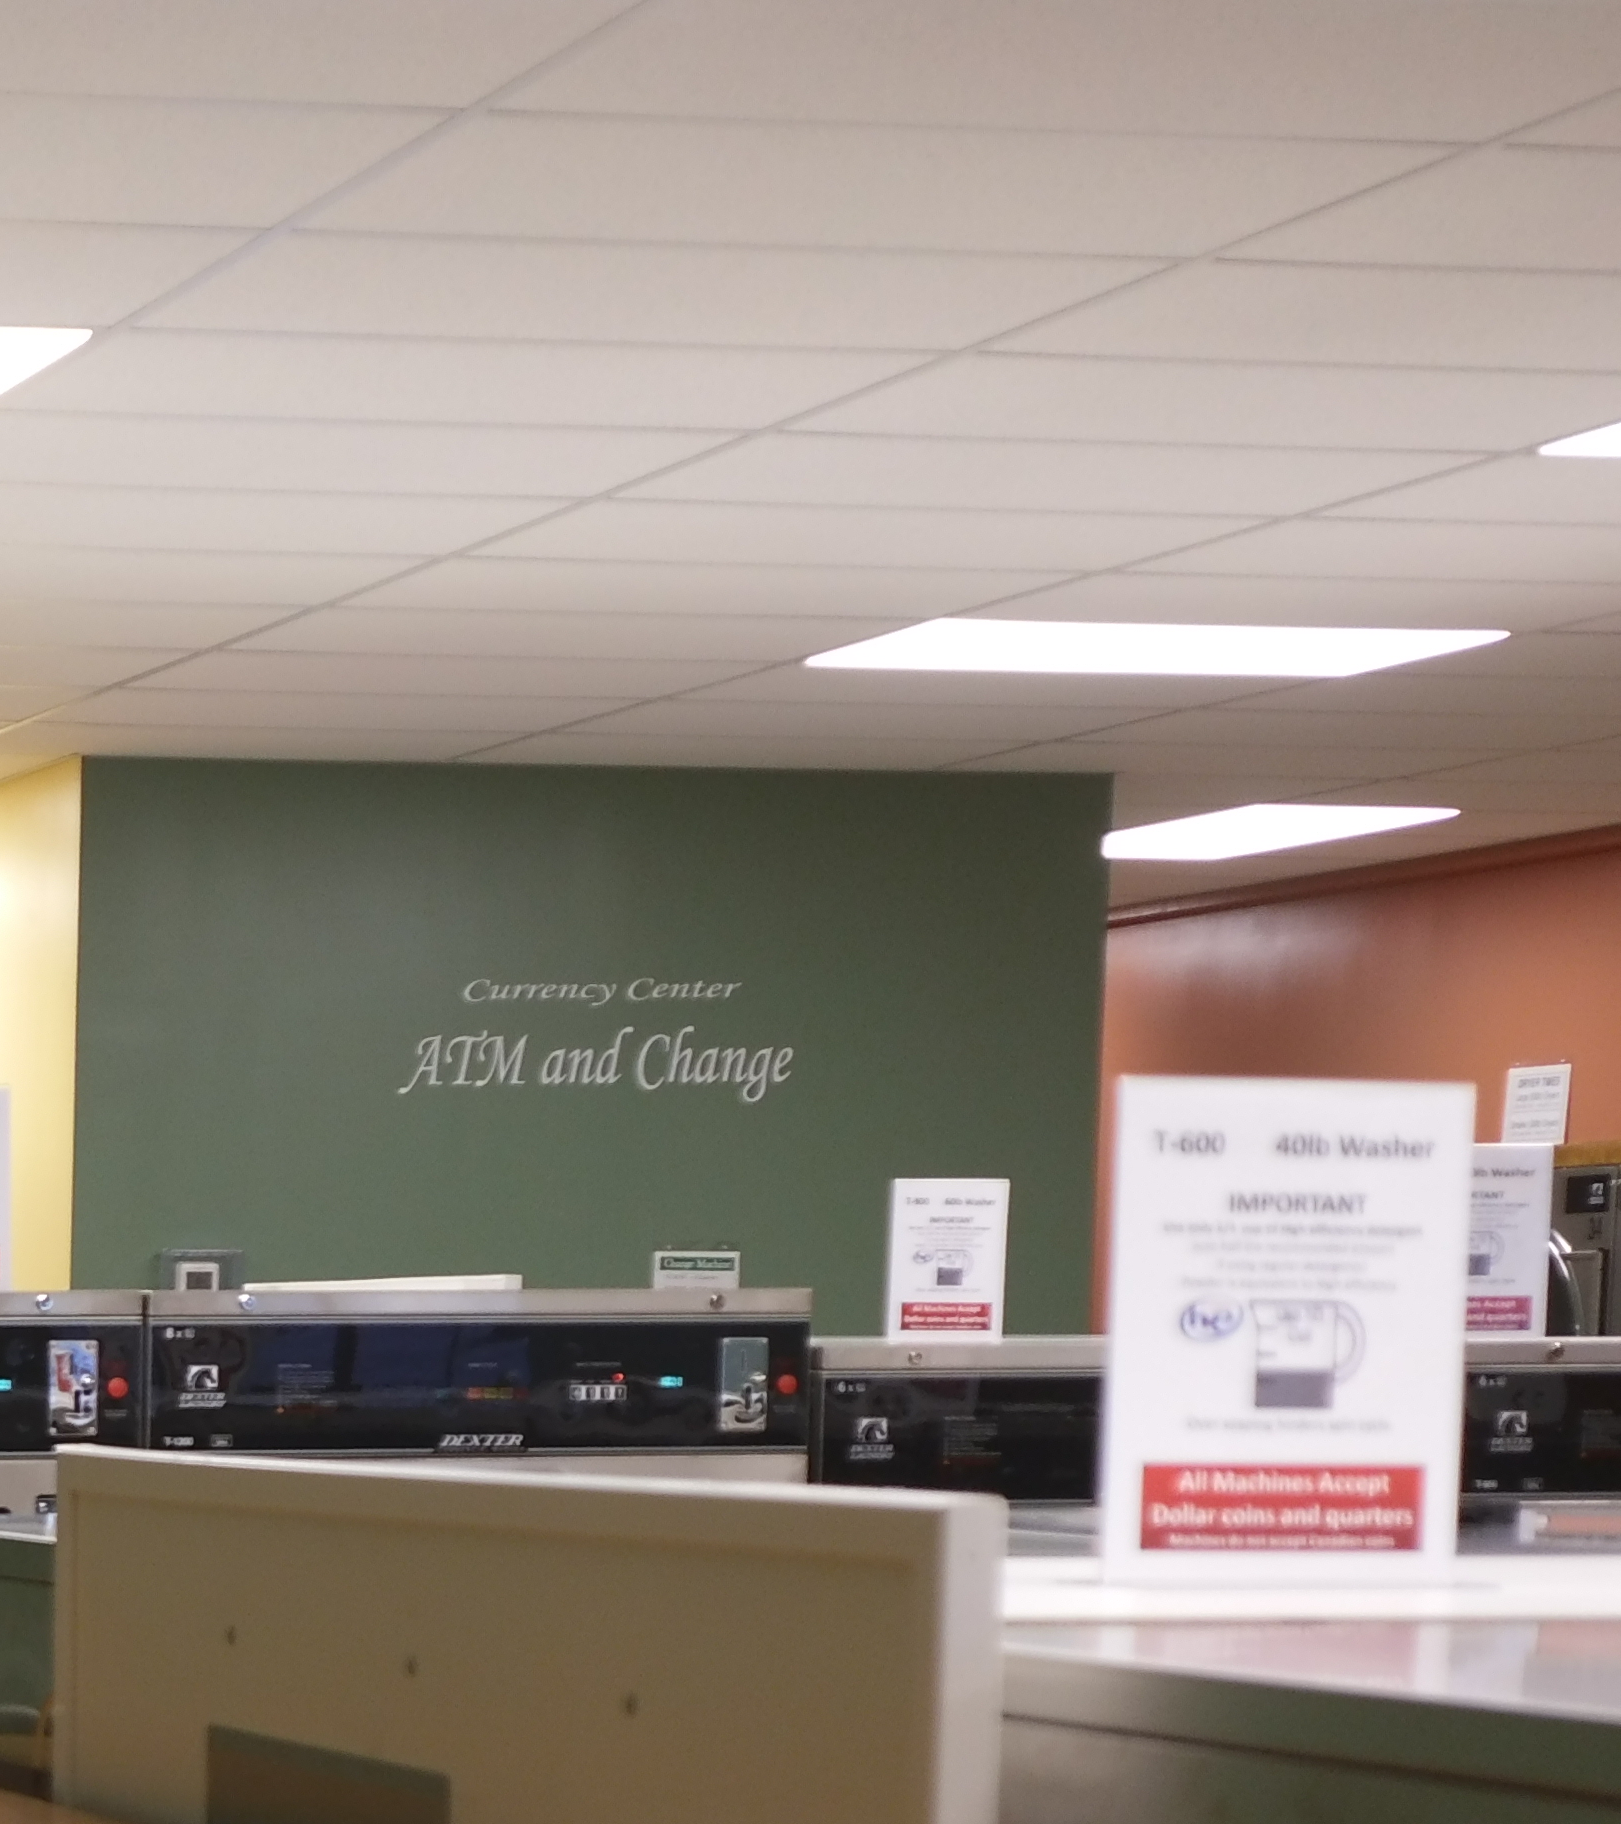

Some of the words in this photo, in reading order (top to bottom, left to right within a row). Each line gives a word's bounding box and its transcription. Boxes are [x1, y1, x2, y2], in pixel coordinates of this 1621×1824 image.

[463, 979, 616, 1006] Currency
[627, 977, 742, 1000] Center
[398, 1030, 529, 1094] ATM
[539, 1026, 634, 1085] and
[637, 1025, 794, 1102] Change
[1154, 1130, 1226, 1154] T-600
[1276, 1133, 1331, 1157] 40lb
[1339, 1134, 1435, 1158] Washer
[1229, 1192, 1367, 1214] IMPORTANT
[440, 1434, 524, 1447] DEXTER
[1178, 1470, 1207, 1494] All
[1213, 1470, 1314, 1494] Machines
[1320, 1472, 1390, 1498] Accept
[1152, 1503, 1216, 1527] Dollar
[1221, 1504, 1276, 1527] coins
[1281, 1504, 1321, 1527] and
[1325, 1506, 1415, 1530] quarters
